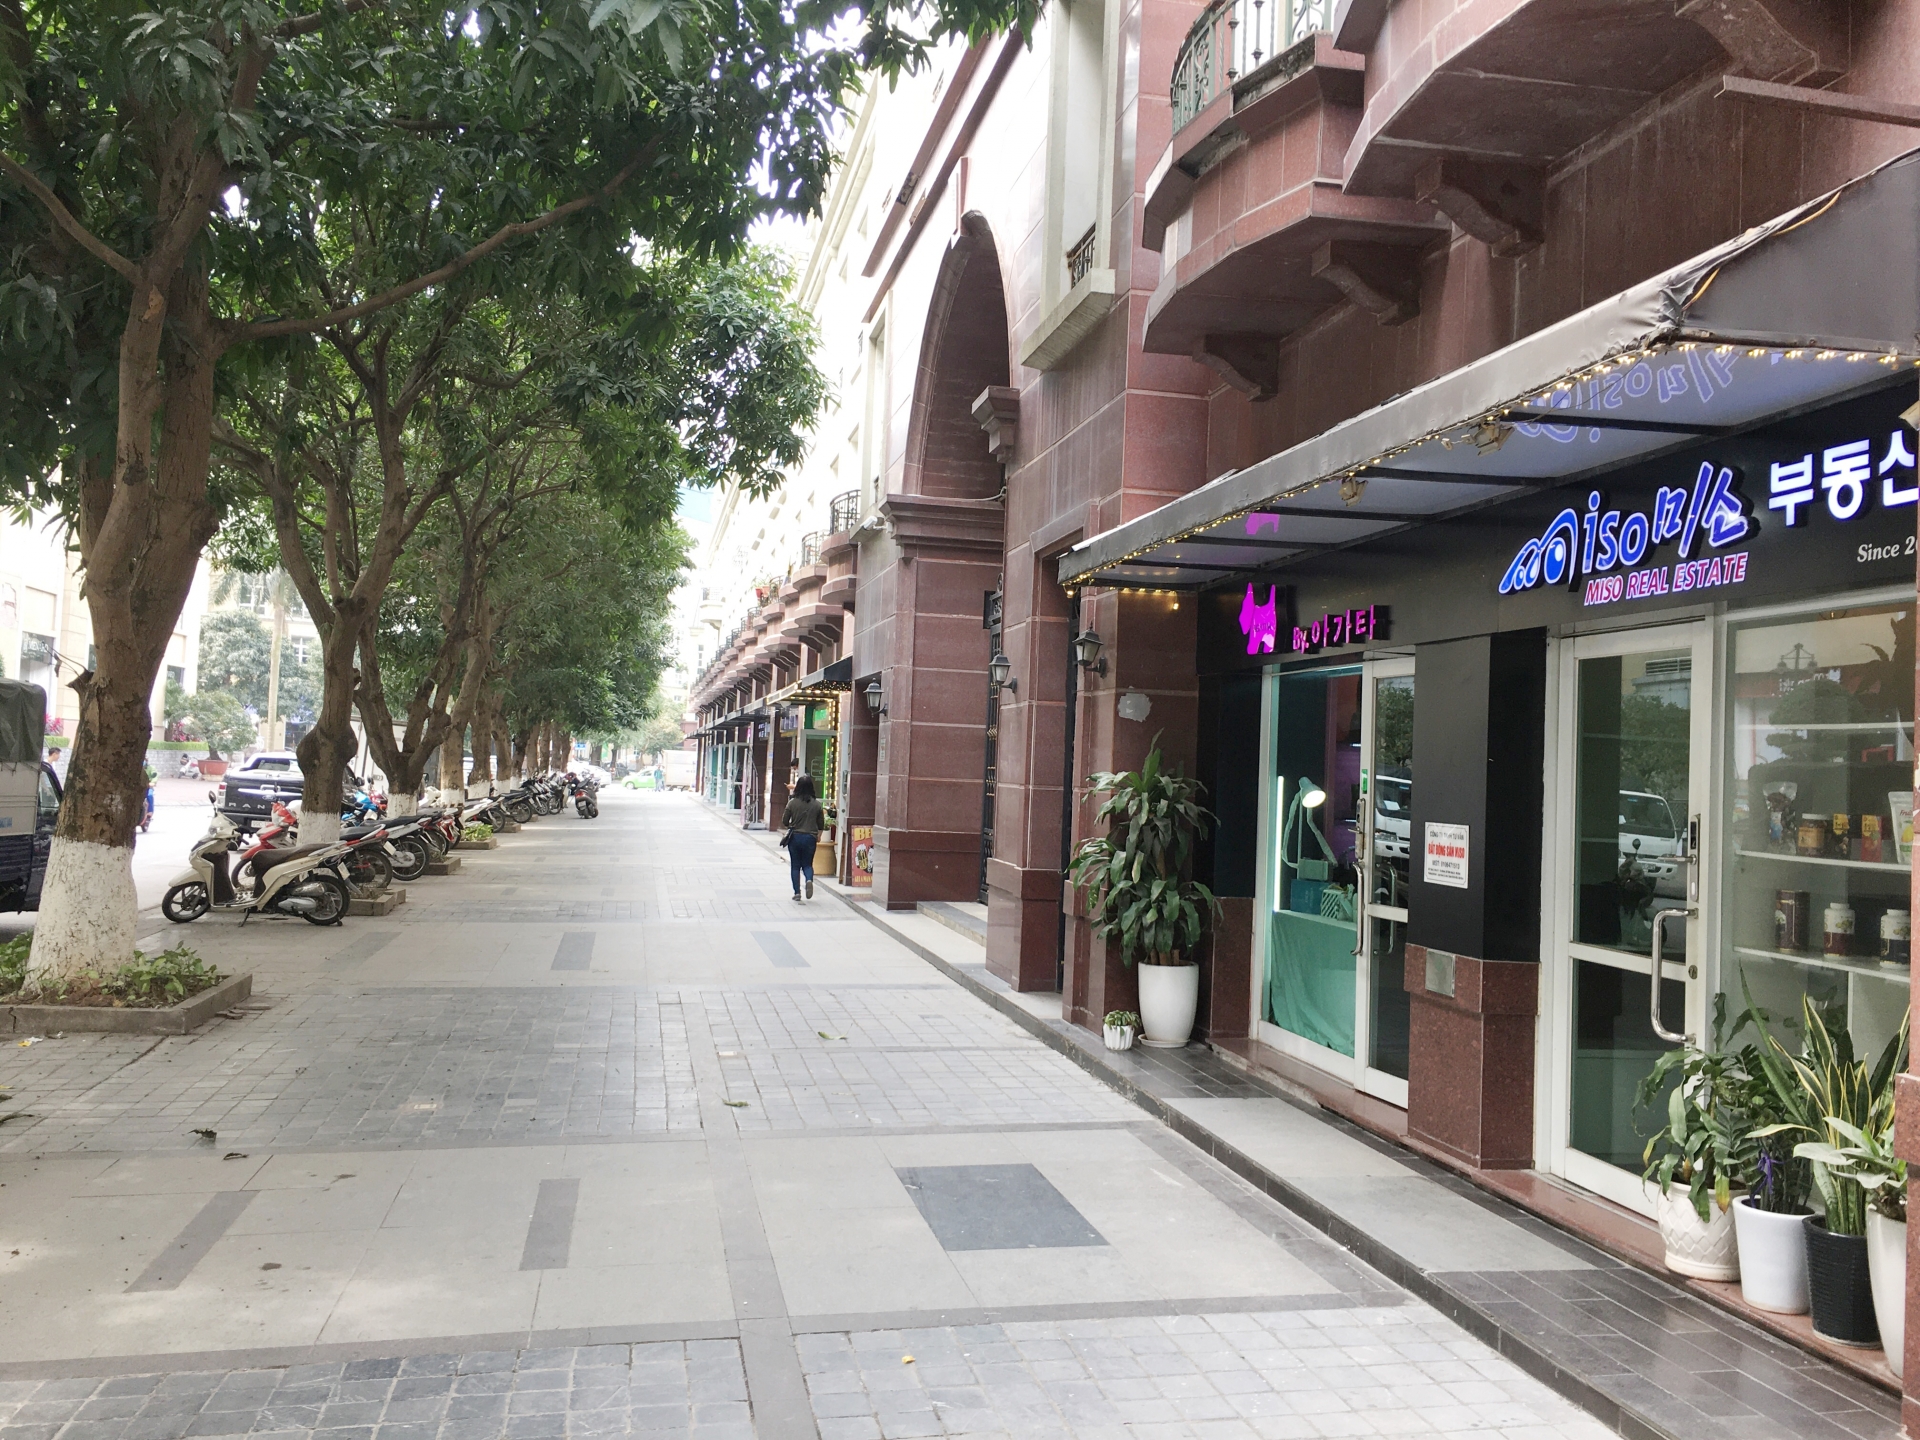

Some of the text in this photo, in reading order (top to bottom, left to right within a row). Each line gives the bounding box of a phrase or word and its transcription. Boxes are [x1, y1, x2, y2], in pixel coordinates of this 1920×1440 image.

[1856, 535, 1917, 563] Since 2
[1583, 551, 1749, 606] MISO REAL ESTATE
